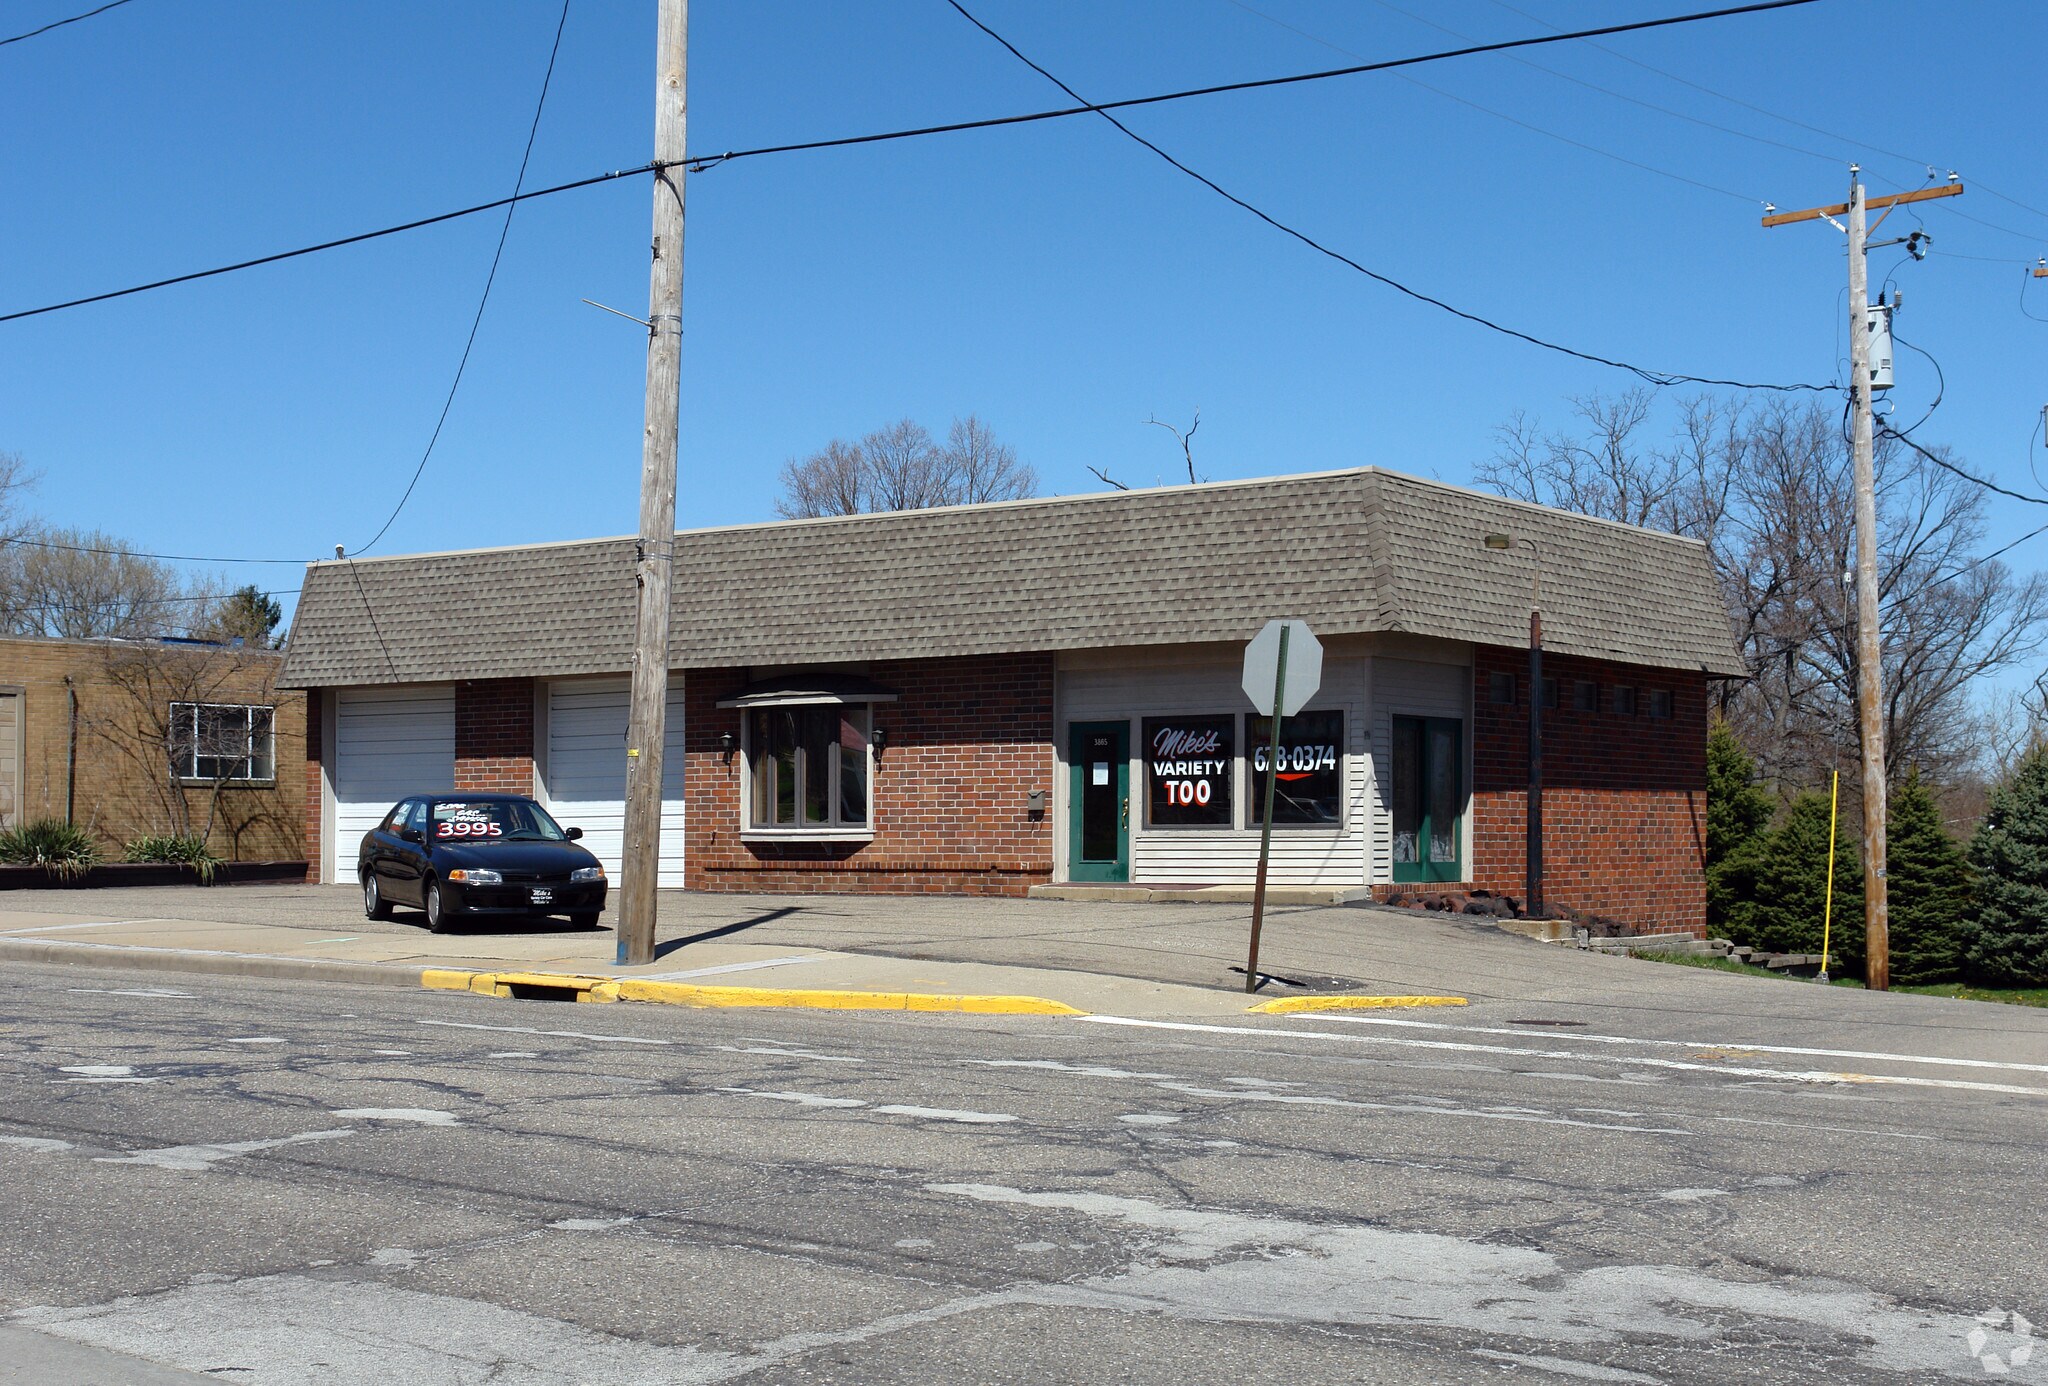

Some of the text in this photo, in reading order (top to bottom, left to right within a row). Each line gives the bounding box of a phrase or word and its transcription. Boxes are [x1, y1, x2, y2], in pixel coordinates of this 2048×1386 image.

[1153, 727, 1221, 759] Mike's
[1153, 760, 1226, 776] VARIETY
[1165, 779, 1211, 805] TOO
[437, 822, 503, 837] 3995
